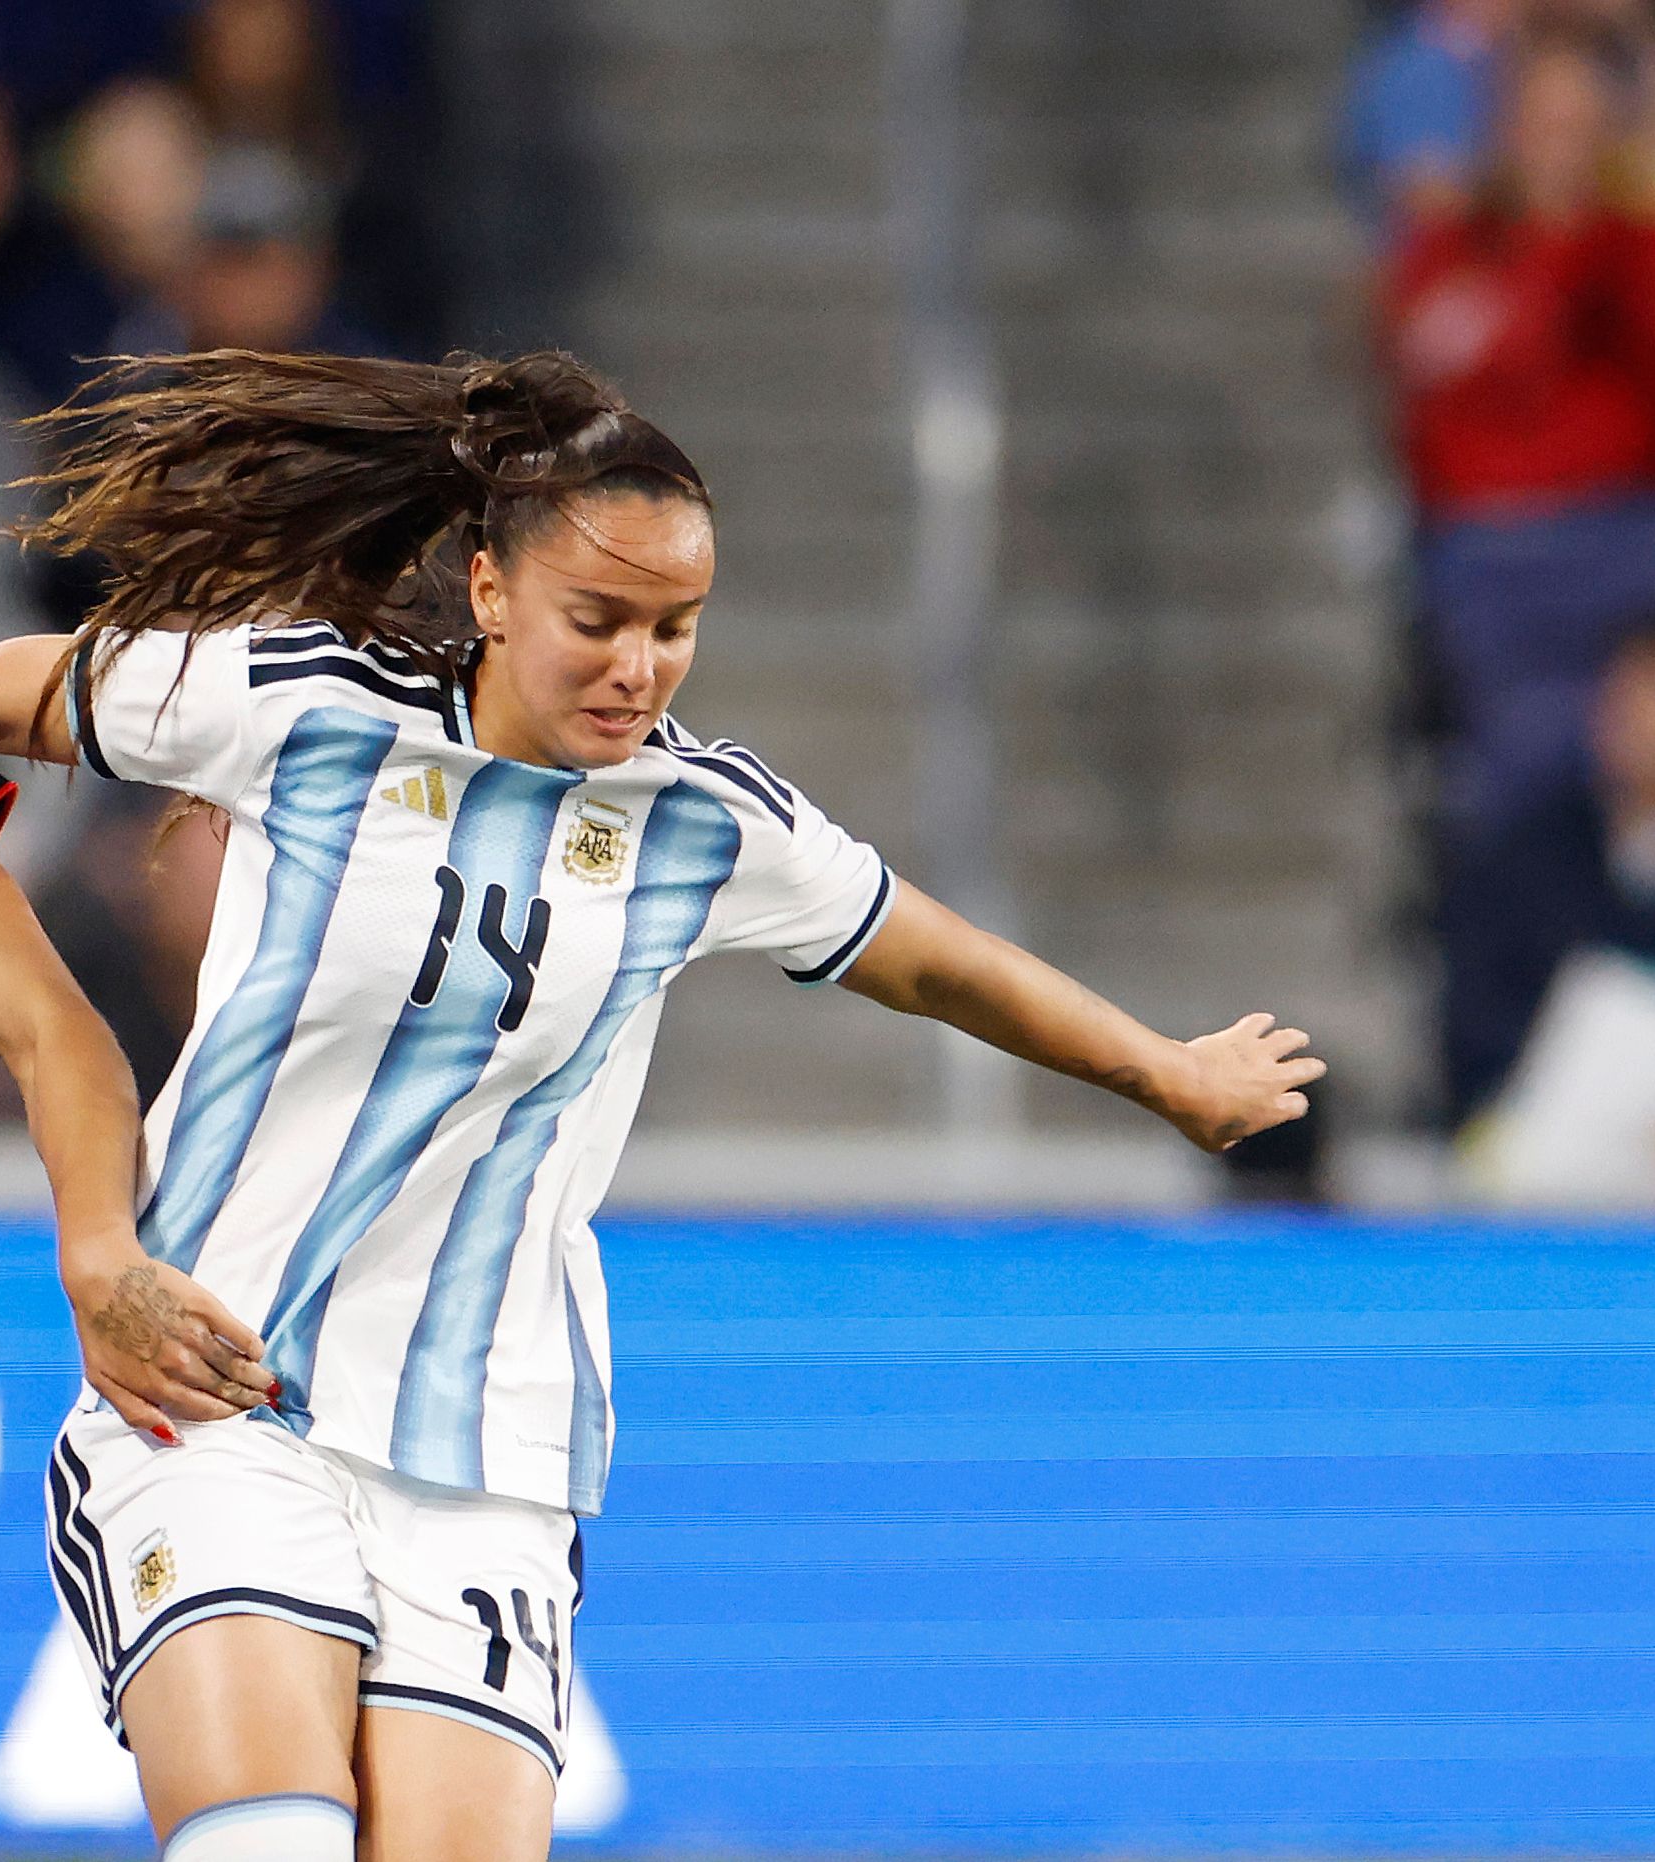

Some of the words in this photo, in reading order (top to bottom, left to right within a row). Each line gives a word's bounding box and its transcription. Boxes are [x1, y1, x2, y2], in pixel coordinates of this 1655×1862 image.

[575, 822, 614, 864] AFA
[409, 864, 552, 1033] 14
[460, 1587, 562, 1732] 14
